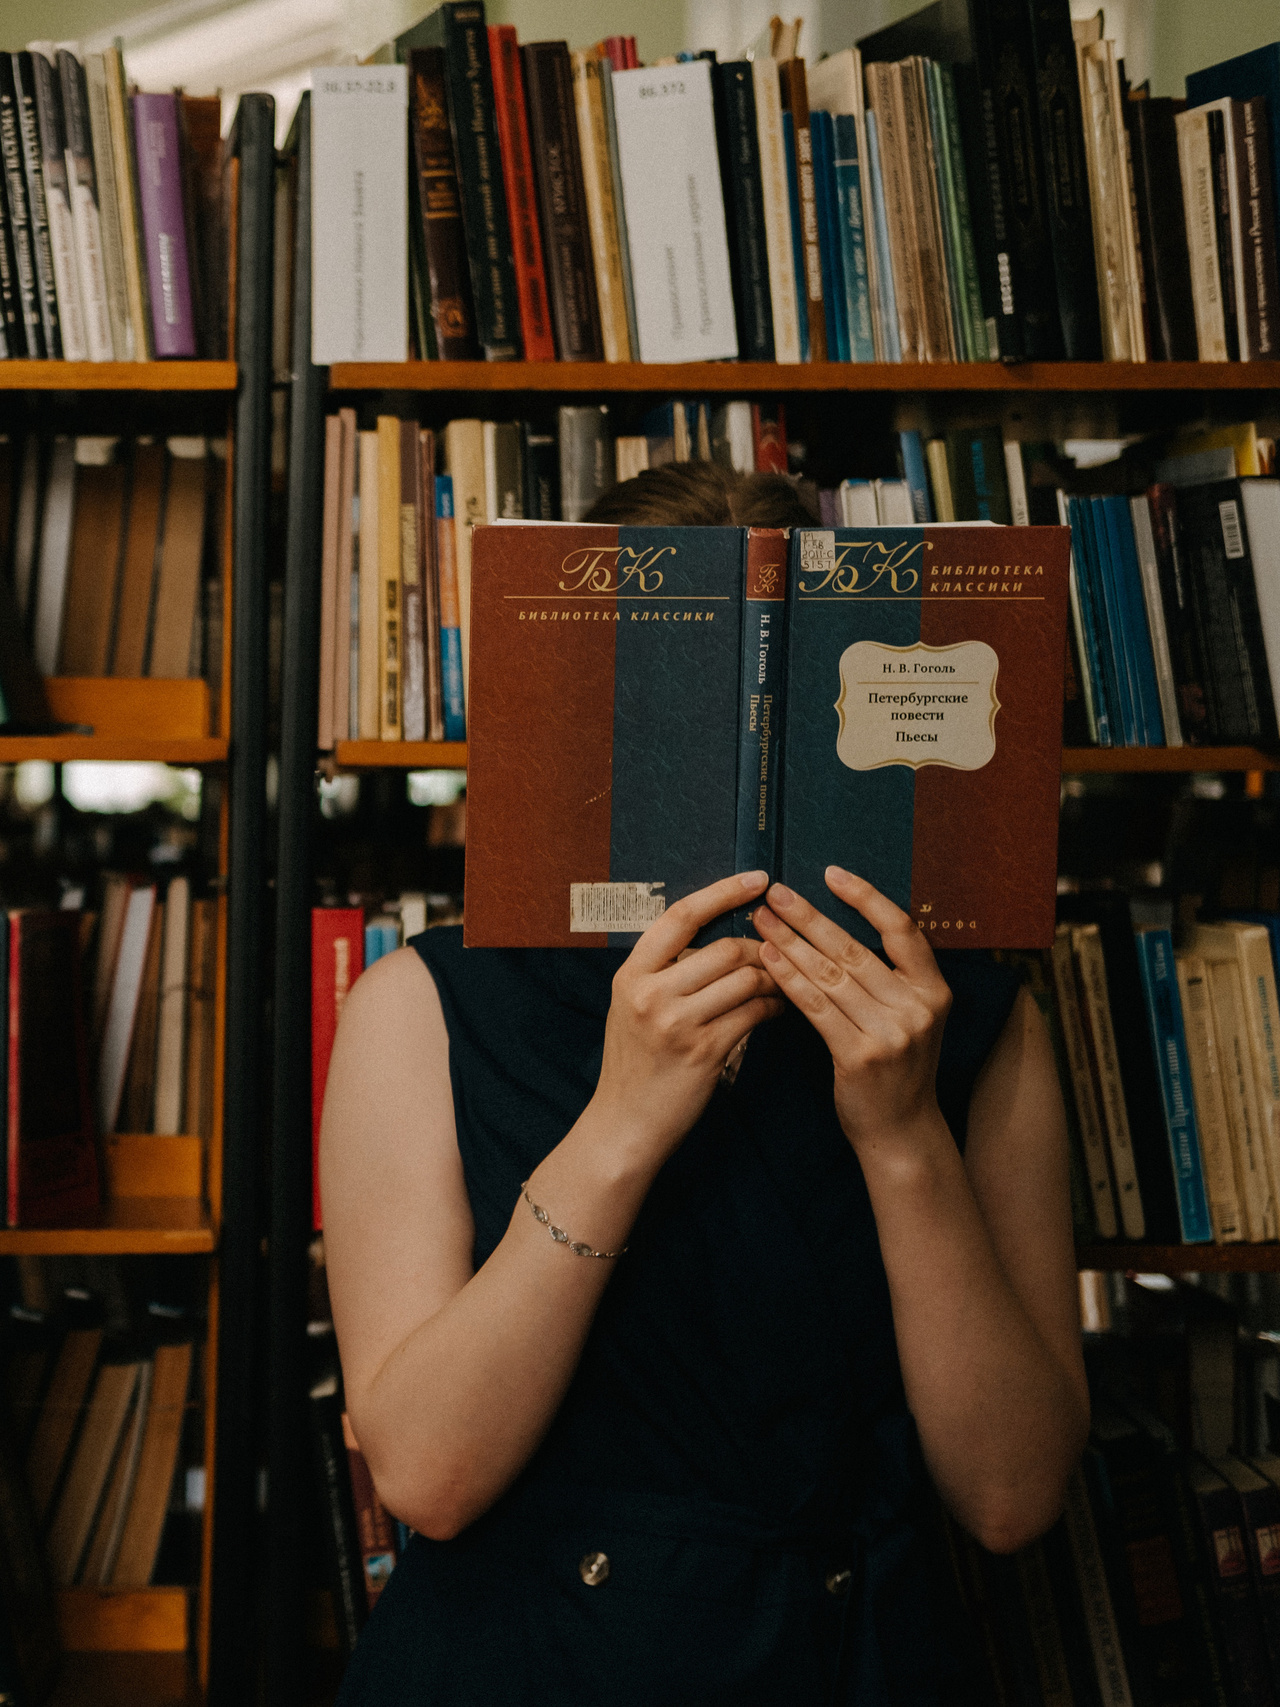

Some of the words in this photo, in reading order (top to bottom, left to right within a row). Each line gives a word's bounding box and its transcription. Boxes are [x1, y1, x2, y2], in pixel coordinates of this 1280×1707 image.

[559, 546, 677, 593] БК
[803, 560, 831, 569] 5157
[931, 565, 1045, 576] БИБЛИОТЕКА
[930, 582, 1024, 592] КЛАССИКИ
[518, 611, 621, 621] БИБЛИОТЕКА
[630, 611, 715, 621] КЛАССИКИ
[760, 613, 770, 627] Н.
[759, 628, 770, 642] В.
[757, 644, 770, 684] Гоголь
[882, 663, 895, 673] Н.
[899, 663, 910, 673] В.
[913, 663, 956, 673] Гоголь
[868, 692, 969, 706] Петербургские
[748, 693, 760, 732] Пьесы
[890, 712, 944, 721] повести
[758, 694, 773, 782] Петербургские
[895, 731, 938, 742] Пьесы
[757, 784, 769, 832] повести
